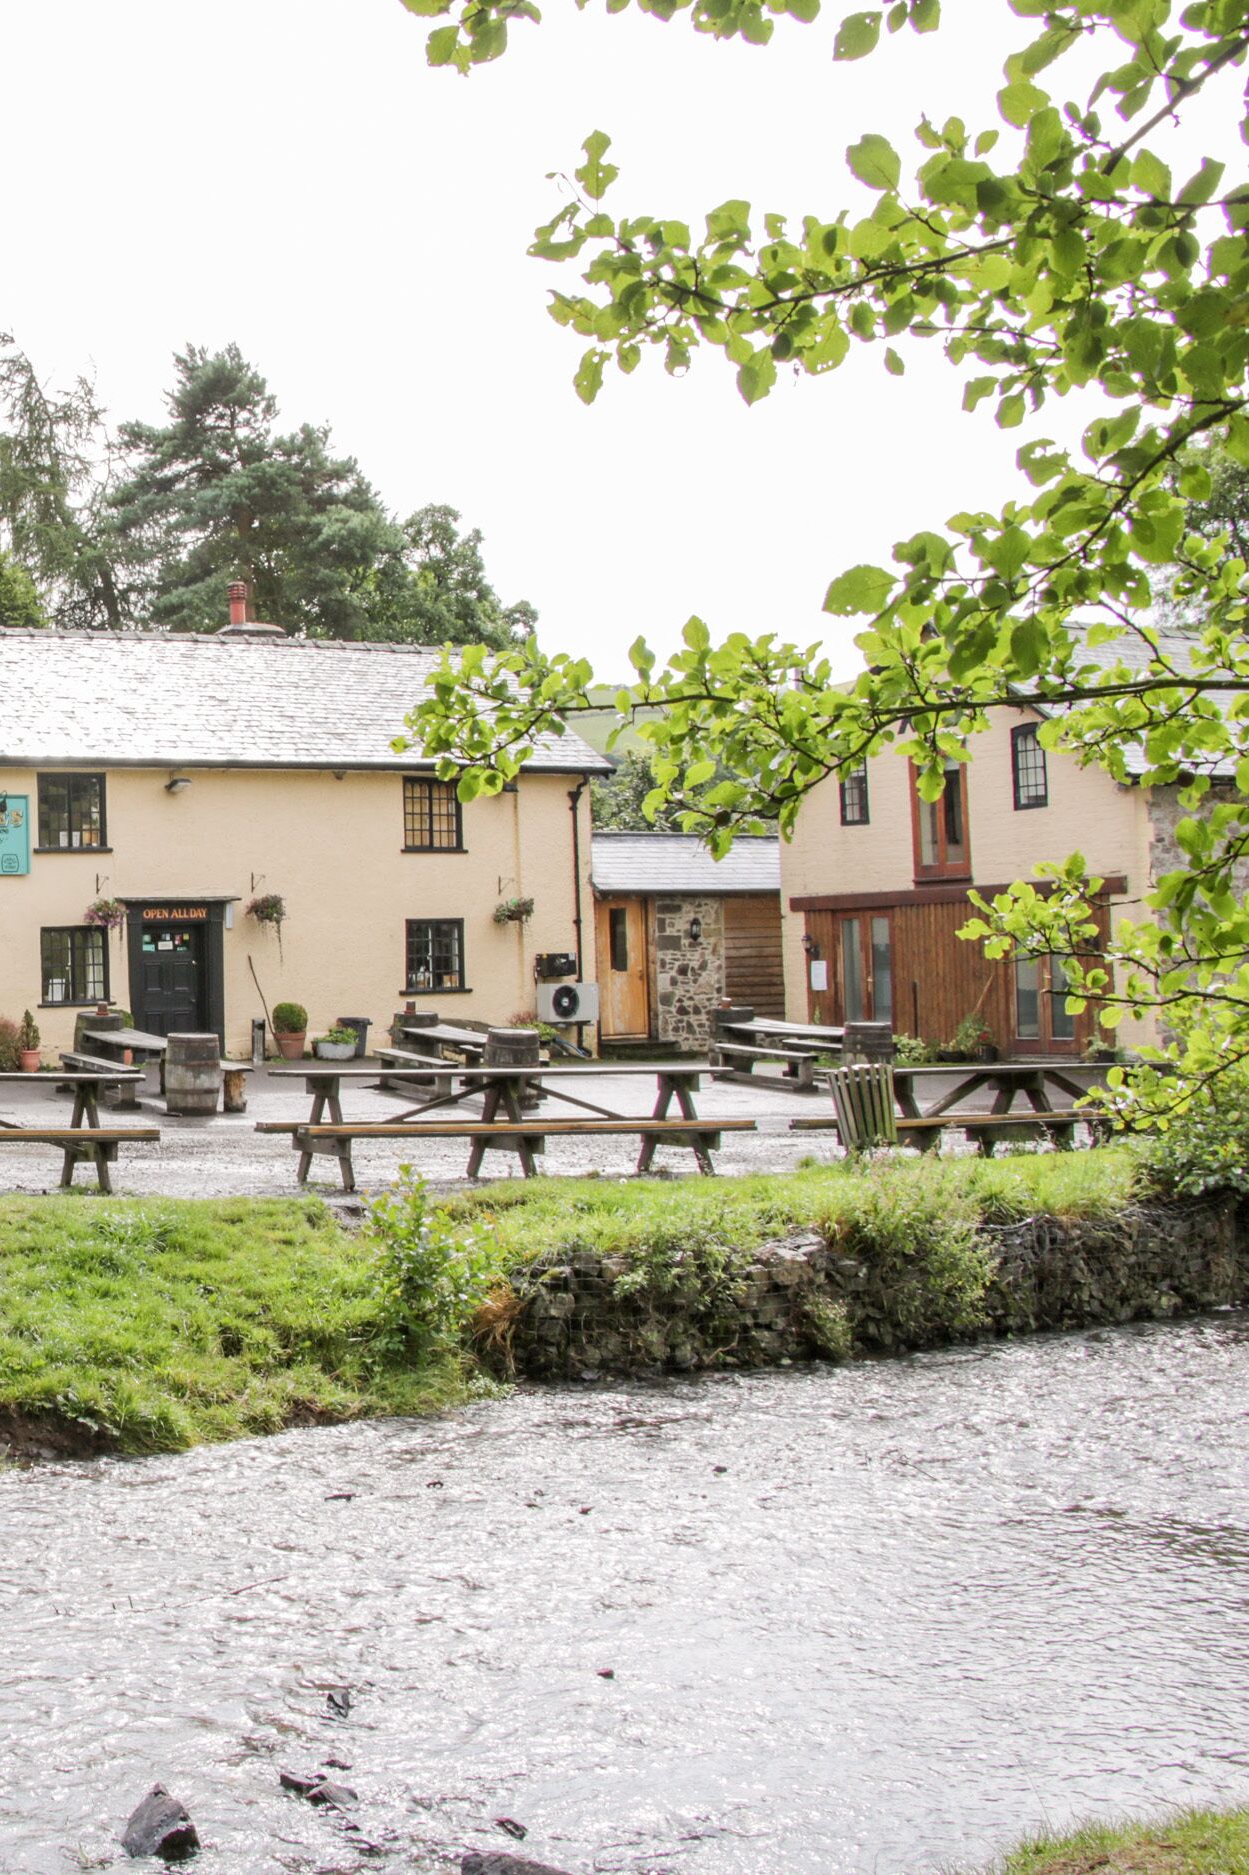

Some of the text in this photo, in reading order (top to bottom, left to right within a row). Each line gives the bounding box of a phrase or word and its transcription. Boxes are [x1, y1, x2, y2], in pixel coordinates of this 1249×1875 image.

[143, 908, 207, 919] OPEN ALL DAY
